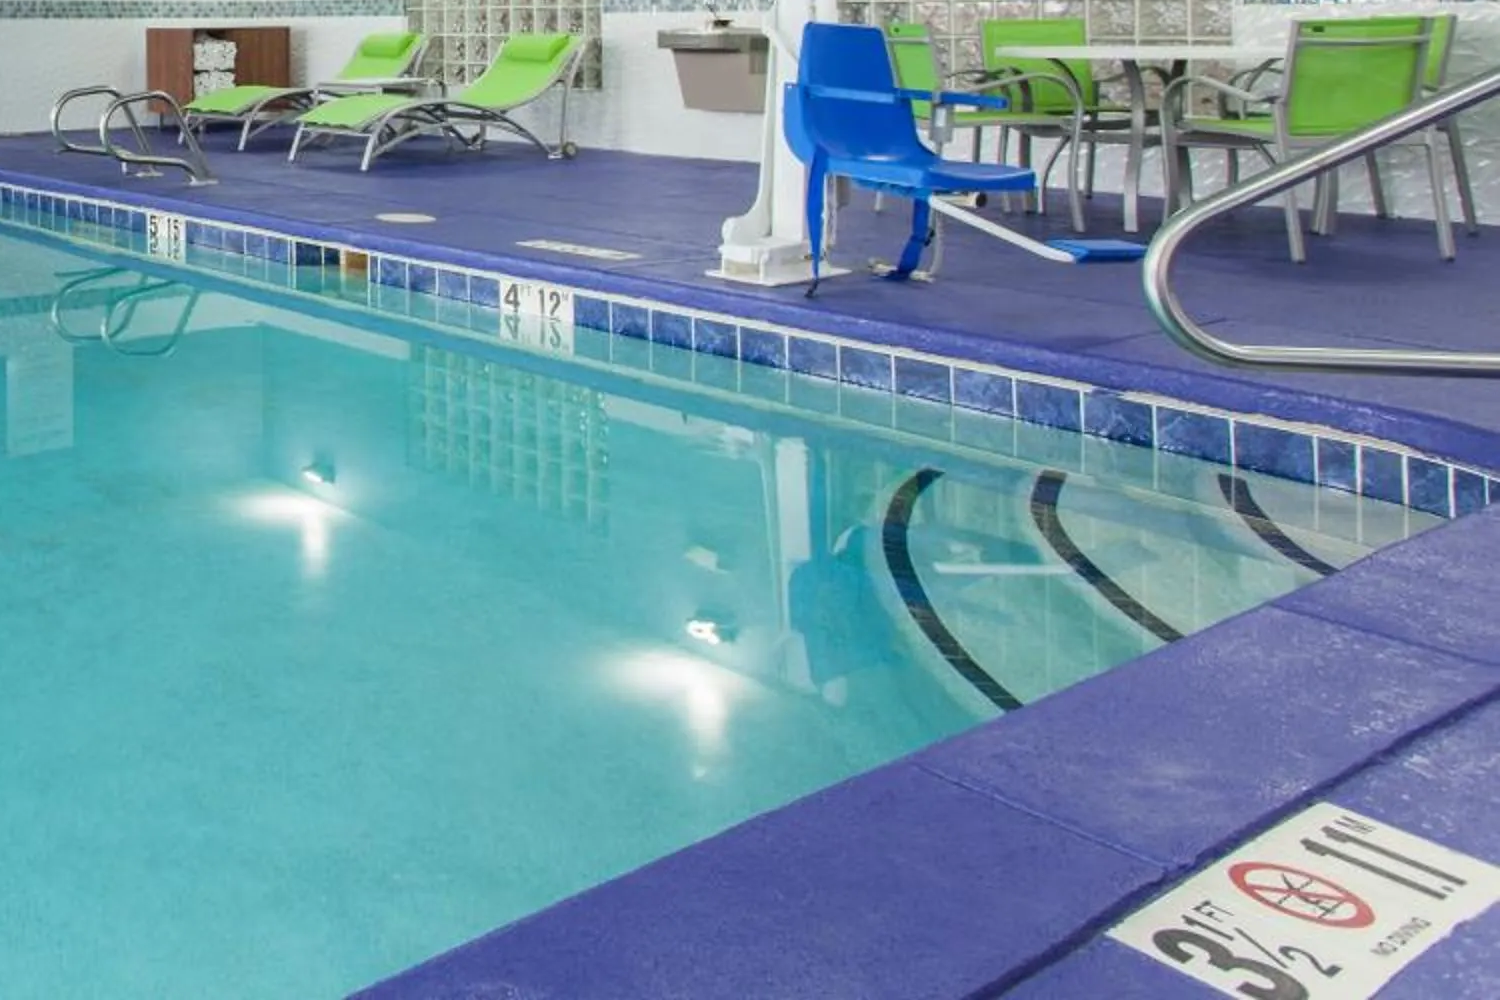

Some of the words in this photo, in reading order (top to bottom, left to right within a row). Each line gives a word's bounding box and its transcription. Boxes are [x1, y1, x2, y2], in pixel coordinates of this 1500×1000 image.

[504, 284, 520, 314] 4
[538, 288, 561, 321] 12
[1386, 916, 1432, 946] DIVING
